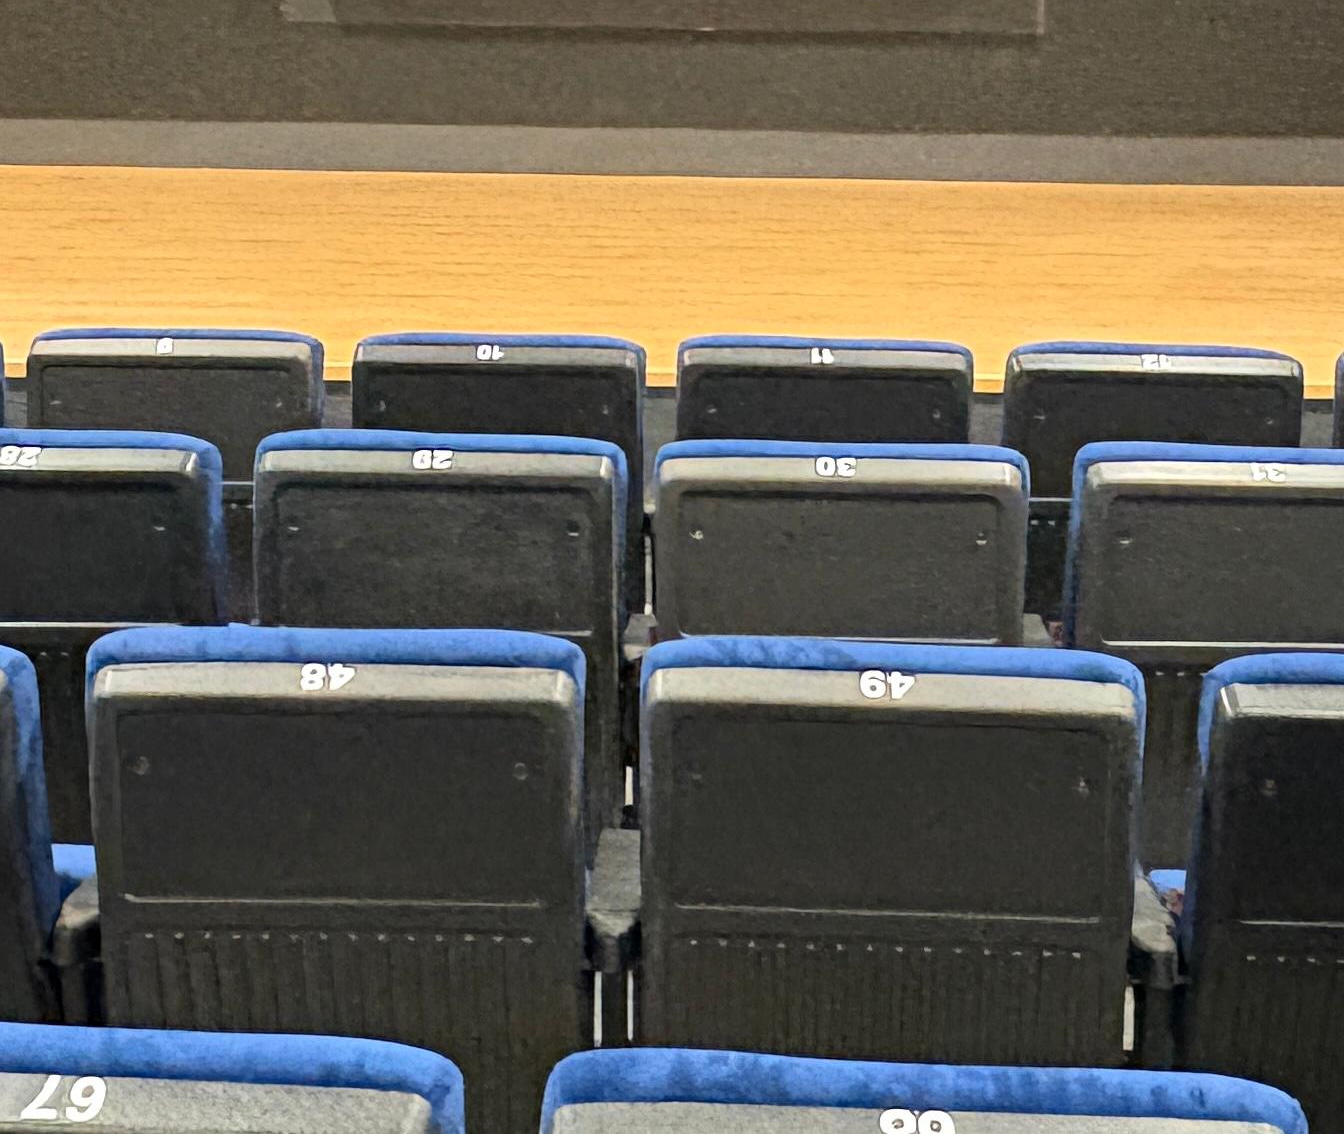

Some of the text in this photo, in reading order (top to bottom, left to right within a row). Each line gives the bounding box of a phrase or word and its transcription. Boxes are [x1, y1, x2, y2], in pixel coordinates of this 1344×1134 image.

[815, 456, 858, 477] 30
[300, 663, 355, 691] 48
[860, 670, 915, 699] 49
[20, 1074, 107, 1122] 67
